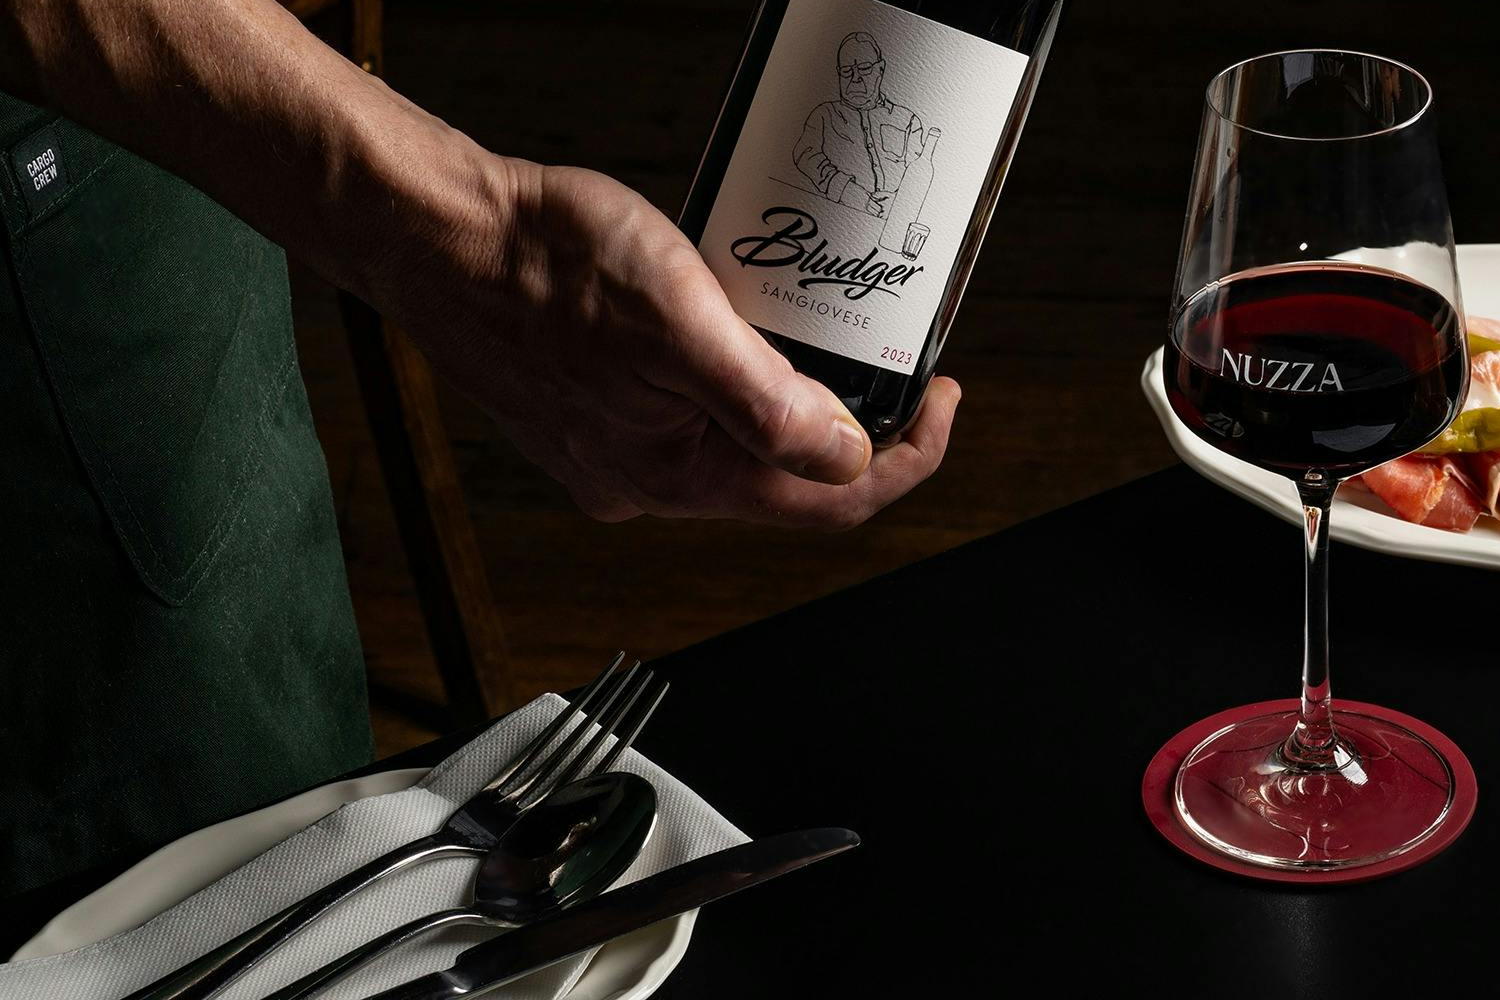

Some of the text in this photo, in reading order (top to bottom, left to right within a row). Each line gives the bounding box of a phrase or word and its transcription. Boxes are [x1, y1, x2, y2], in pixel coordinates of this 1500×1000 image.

[27, 148, 55, 177] CARGO
[33, 164, 58, 190] CREW
[731, 206, 924, 301] Bludger
[760, 282, 871, 329] SANGIOVESE
[880, 346, 912, 365] 2023
[1220, 347, 1344, 392] NUZZA
